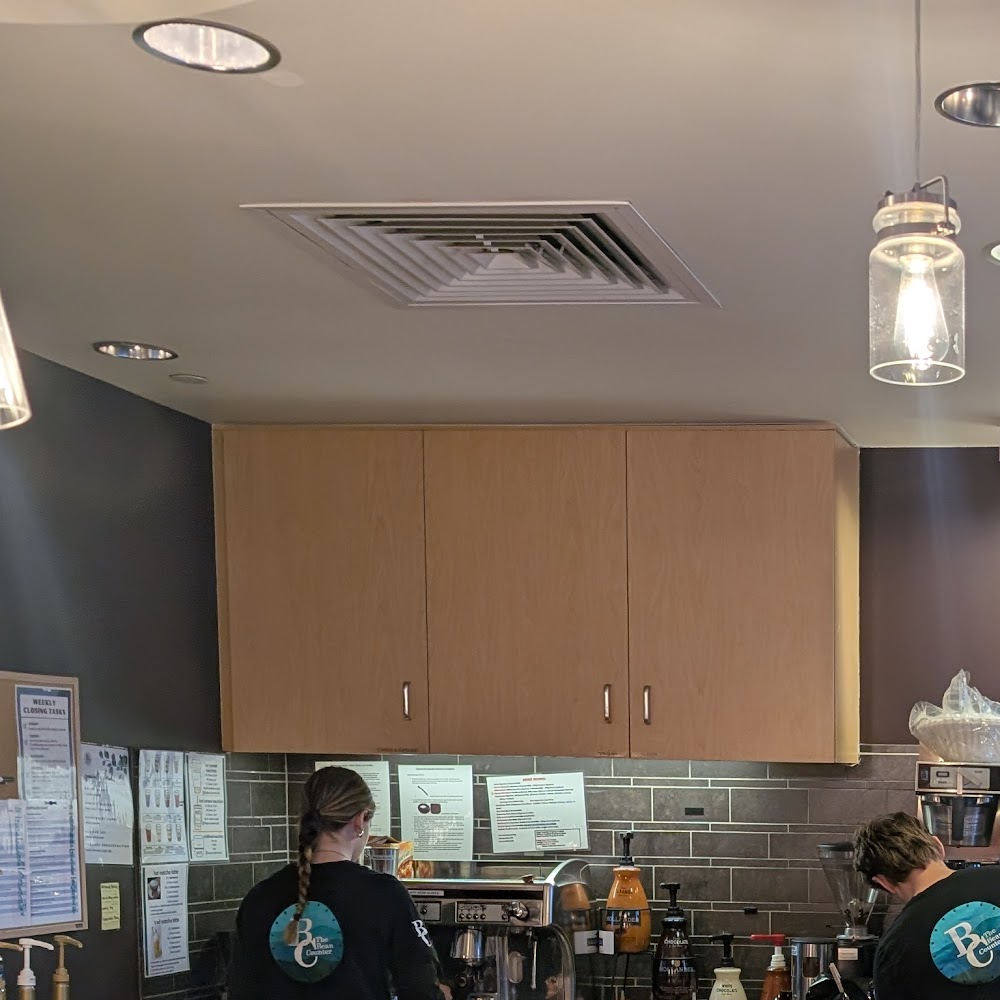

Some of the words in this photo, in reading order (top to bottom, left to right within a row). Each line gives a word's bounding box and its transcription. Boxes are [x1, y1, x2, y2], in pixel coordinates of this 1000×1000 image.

[32, 698, 56, 706] WEEKLY
[23, 707, 48, 715] CLOSING
[984, 927, 997, 938] The
